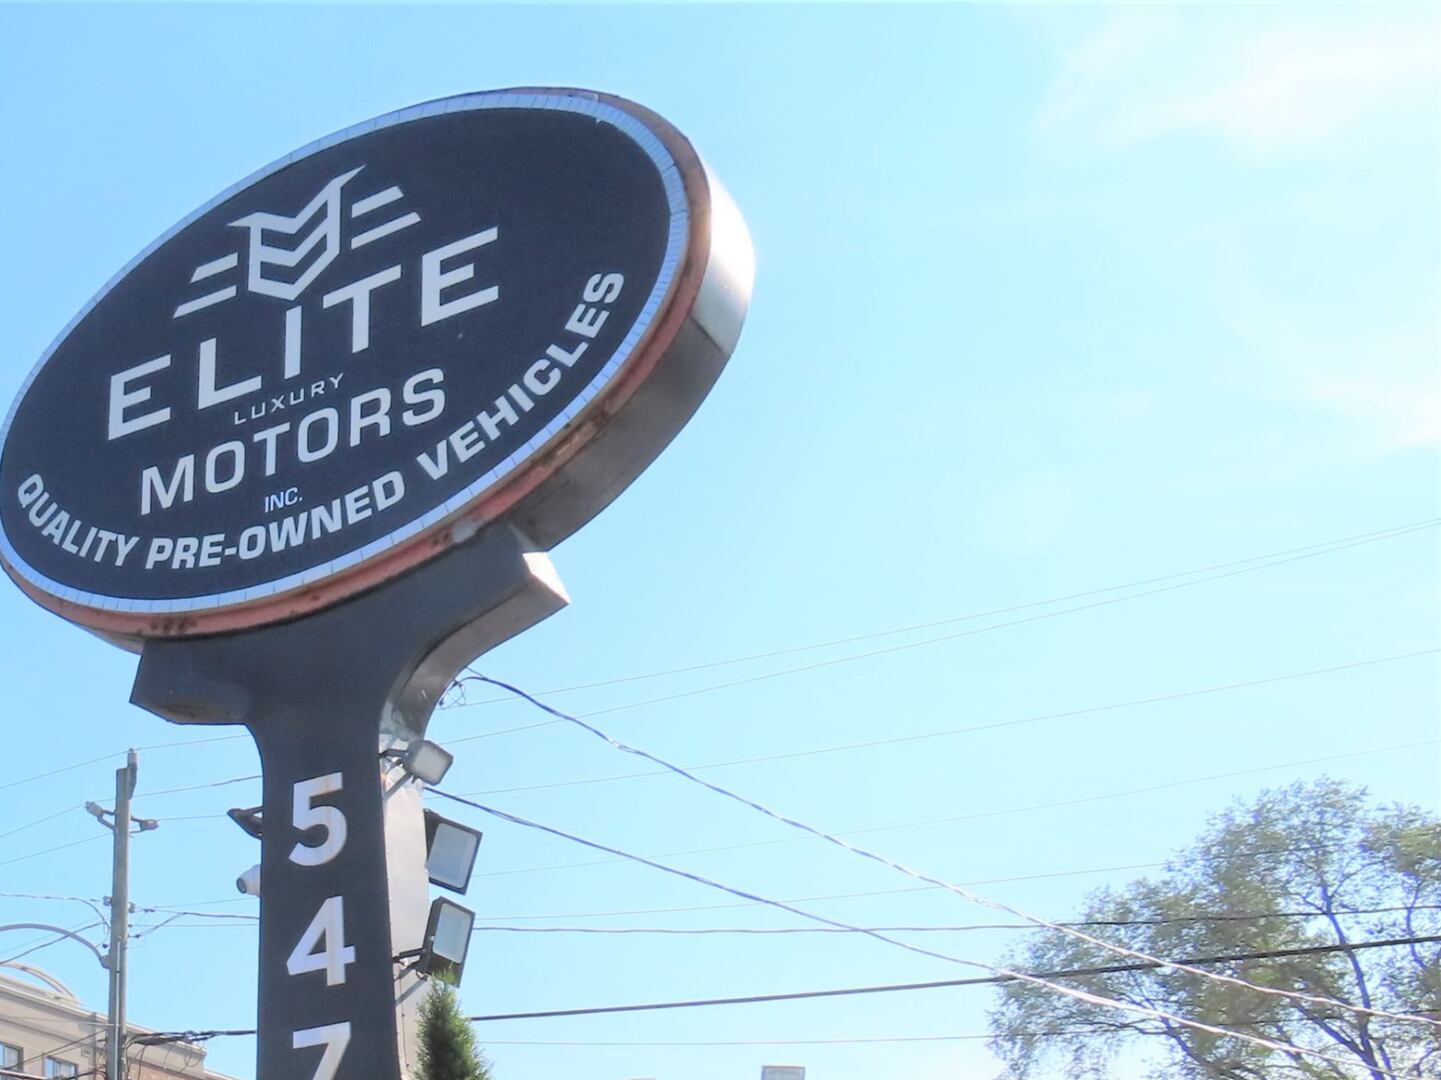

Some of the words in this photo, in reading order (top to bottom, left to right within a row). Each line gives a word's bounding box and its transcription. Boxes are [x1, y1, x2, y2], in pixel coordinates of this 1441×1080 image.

[107, 226, 499, 441] ELITE
[234, 372, 344, 426] LUXURY
[17, 473, 140, 567] QUALITY
[145, 470, 405, 570] PRE-OWNED
[416, 273, 625, 481] VEHICLES
[140, 368, 446, 516] MOTORS
[264, 486, 304, 513] INC.
